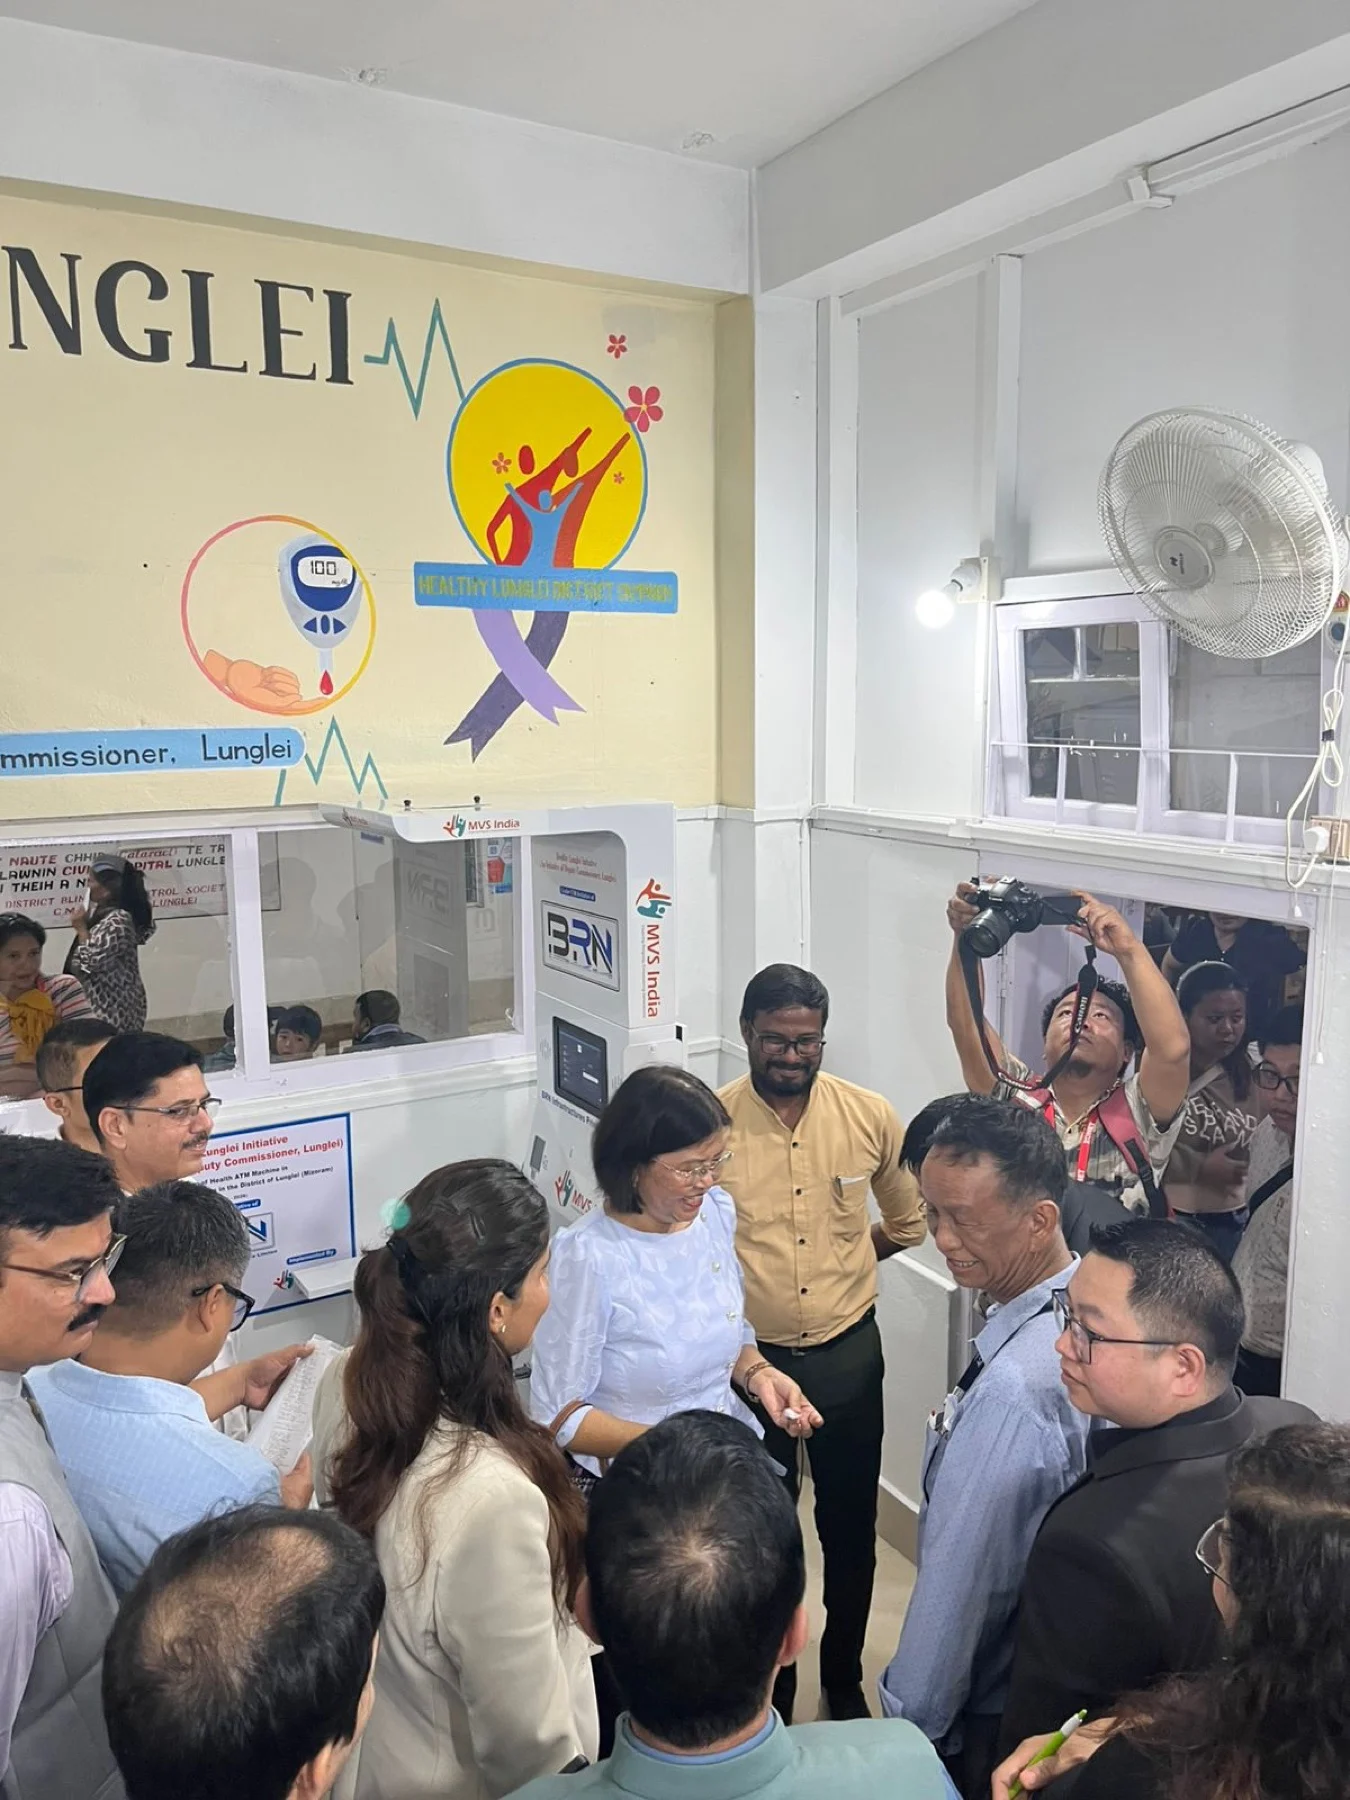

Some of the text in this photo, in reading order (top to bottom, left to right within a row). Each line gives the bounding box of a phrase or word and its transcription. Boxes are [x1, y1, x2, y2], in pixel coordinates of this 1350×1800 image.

[1, 245, 354, 385] NGLEI
[310, 560, 337, 575] 100
[418, 575, 488, 597] HEALTHY
[0, 733, 292, 768] mmissioner, Lunglei
[468, 819, 520, 830] MVS India
[9, 855, 57, 866] NAUTE
[11, 880, 54, 892] THEIH
[60, 880, 69, 889] A
[6, 898, 55, 909] DISTRICT
[152, 896, 198, 908] LUNGLEI
[548, 911, 613, 974] BRN
[646, 924, 661, 1018] MVS India
[242, 1135, 288, 1151] Initiative
[224, 1148, 300, 1167] Commissioner,
[303, 1139, 344, 1153] Lunglei)
[234, 1171, 250, 1181] ATM
[240, 1178, 265, 1188] District
